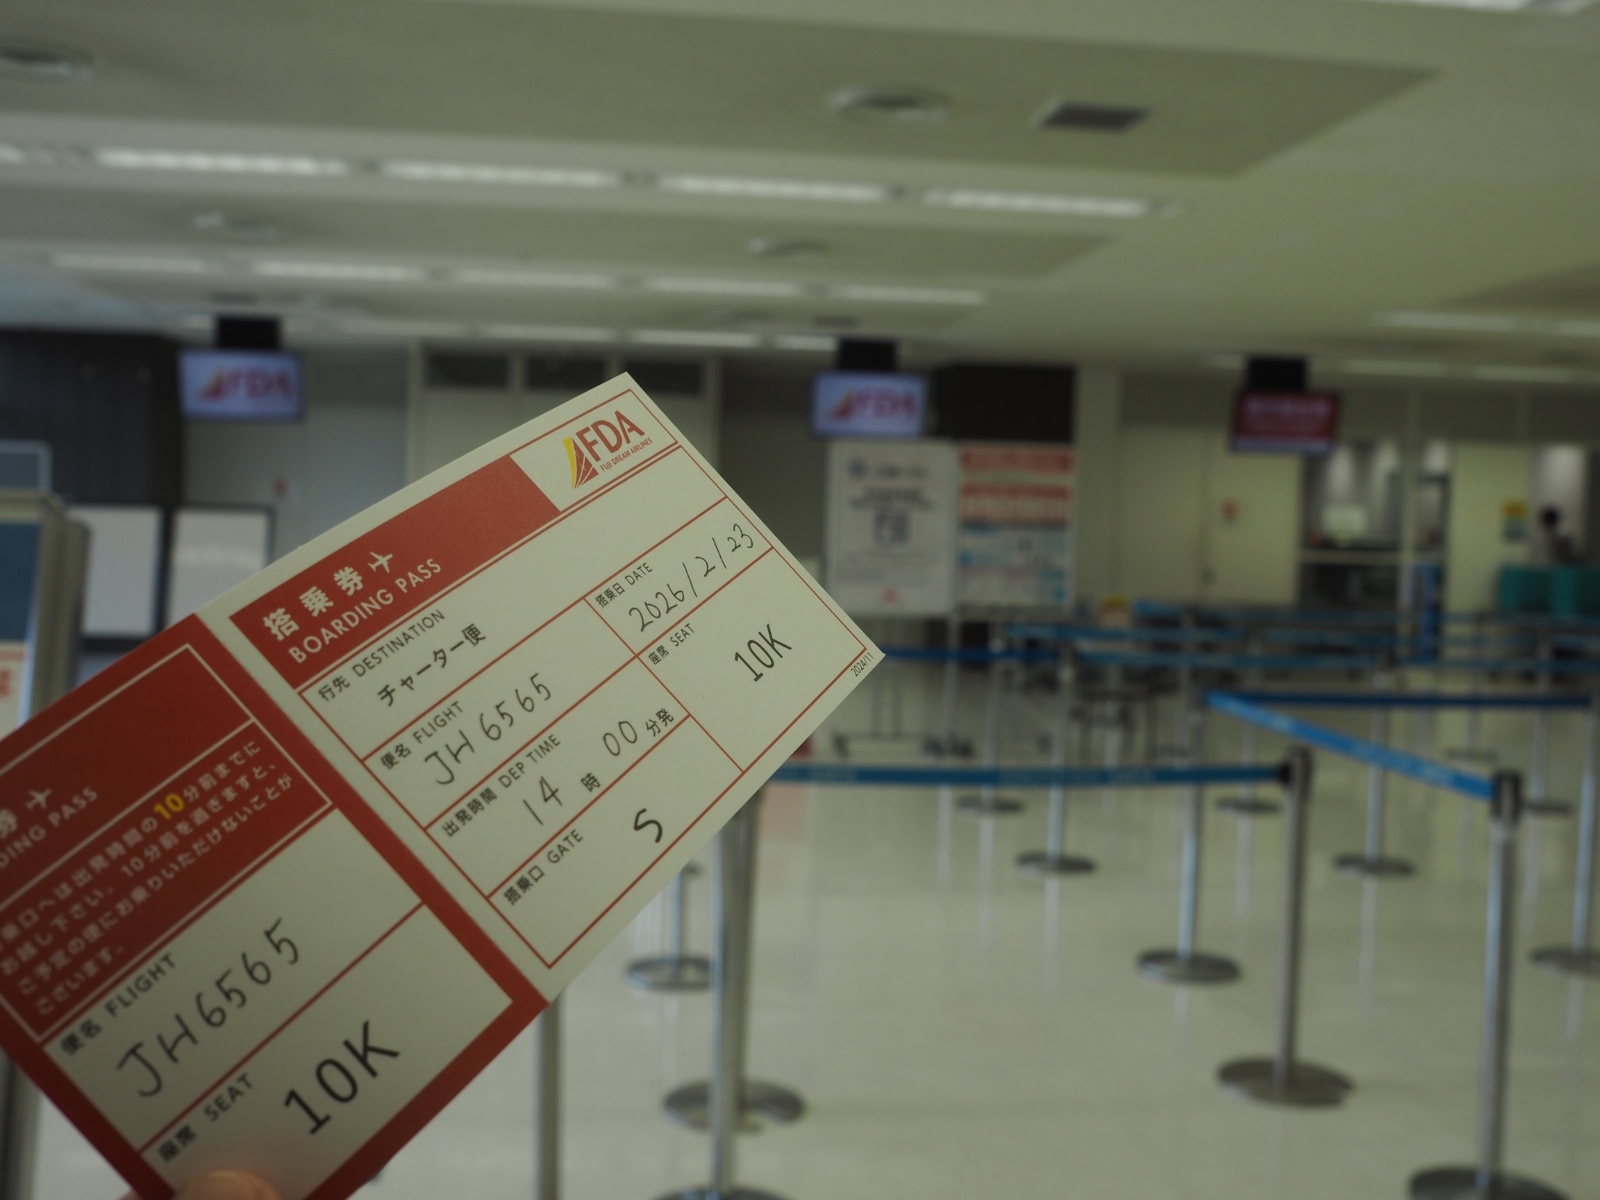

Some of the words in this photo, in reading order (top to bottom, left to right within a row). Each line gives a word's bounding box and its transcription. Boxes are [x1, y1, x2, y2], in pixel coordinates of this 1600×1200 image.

[576, 410, 645, 462] FDA
[600, 461, 613, 472] FUJI
[611, 451, 631, 465] DREAM
[631, 437, 653, 455] AIRLINES
[263, 566, 363, 641] 搭乗券
[594, 582, 625, 609] 搭乗日
[625, 562, 653, 586] DATE
[628, 523, 754, 632] 2026/2/23
[288, 589, 394, 663] BOARDING
[397, 558, 442, 594] PASS
[318, 674, 350, 702] 行先
[352, 609, 446, 678] DESTINATION
[377, 623, 486, 707] チャーター便
[648, 645, 670, 665] 座席
[669, 623, 695, 647] SEAT
[734, 623, 792, 682] 10K
[850, 652, 875, 678] 2024/11
[380, 743, 412, 770] 便名
[412, 701, 464, 744] FLIGHT
[602, 720, 638, 756] 00
[645, 707, 675, 738] 分発
[48, 786, 98, 828] PASS
[441, 787, 498, 837] 出発時間
[498, 761, 526, 788] DEP
[526, 734, 561, 763] TIME
[523, 776, 563, 826] 14
[580, 772, 601, 793] 時
[503, 865, 545, 906] 搭乗口
[546, 829, 583, 864] GATE
[59, 1017, 103, 1056] 便名
[104, 952, 177, 1018] FLIGHT
[283, 1020, 400, 1135] 10K
[157, 1124, 197, 1162] 座席
[203, 1072, 253, 1122] SEAT
